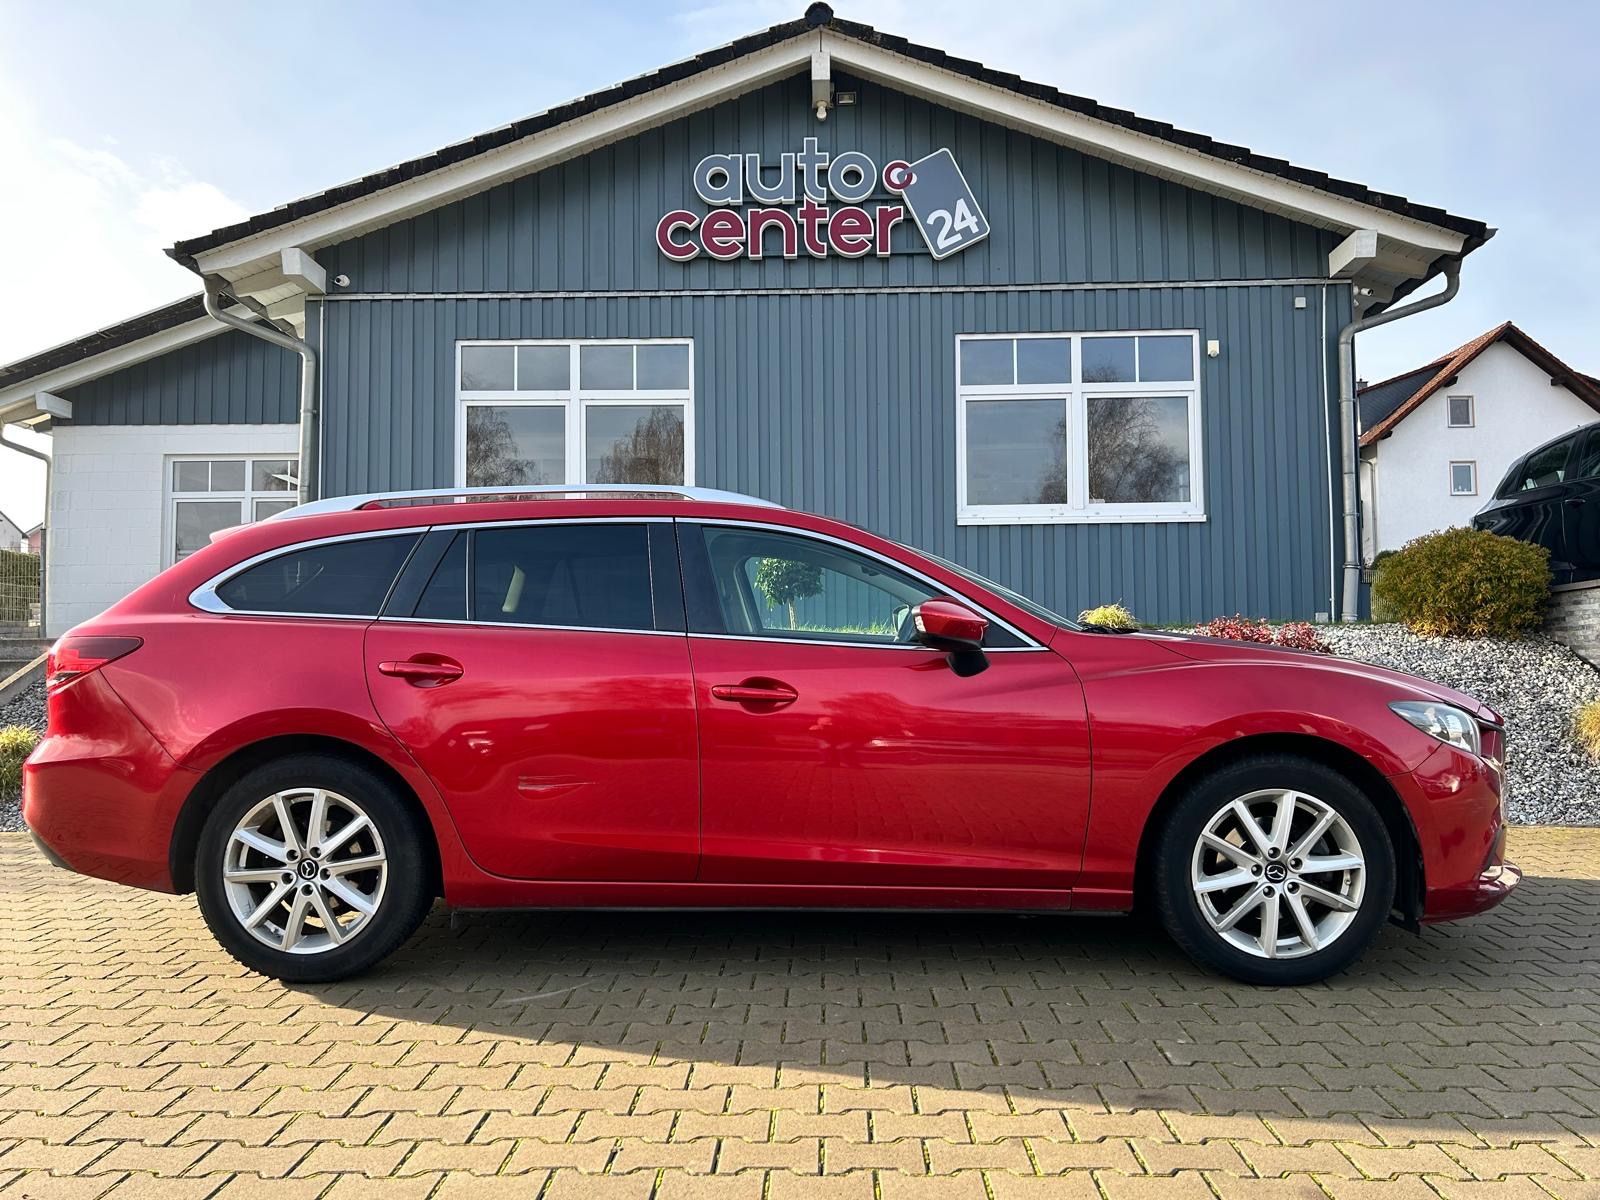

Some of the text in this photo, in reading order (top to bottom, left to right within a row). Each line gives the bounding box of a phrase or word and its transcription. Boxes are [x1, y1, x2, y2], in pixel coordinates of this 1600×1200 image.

[694, 137, 877, 204] auto
[656, 195, 903, 261] center
[926, 198, 979, 250] 24
